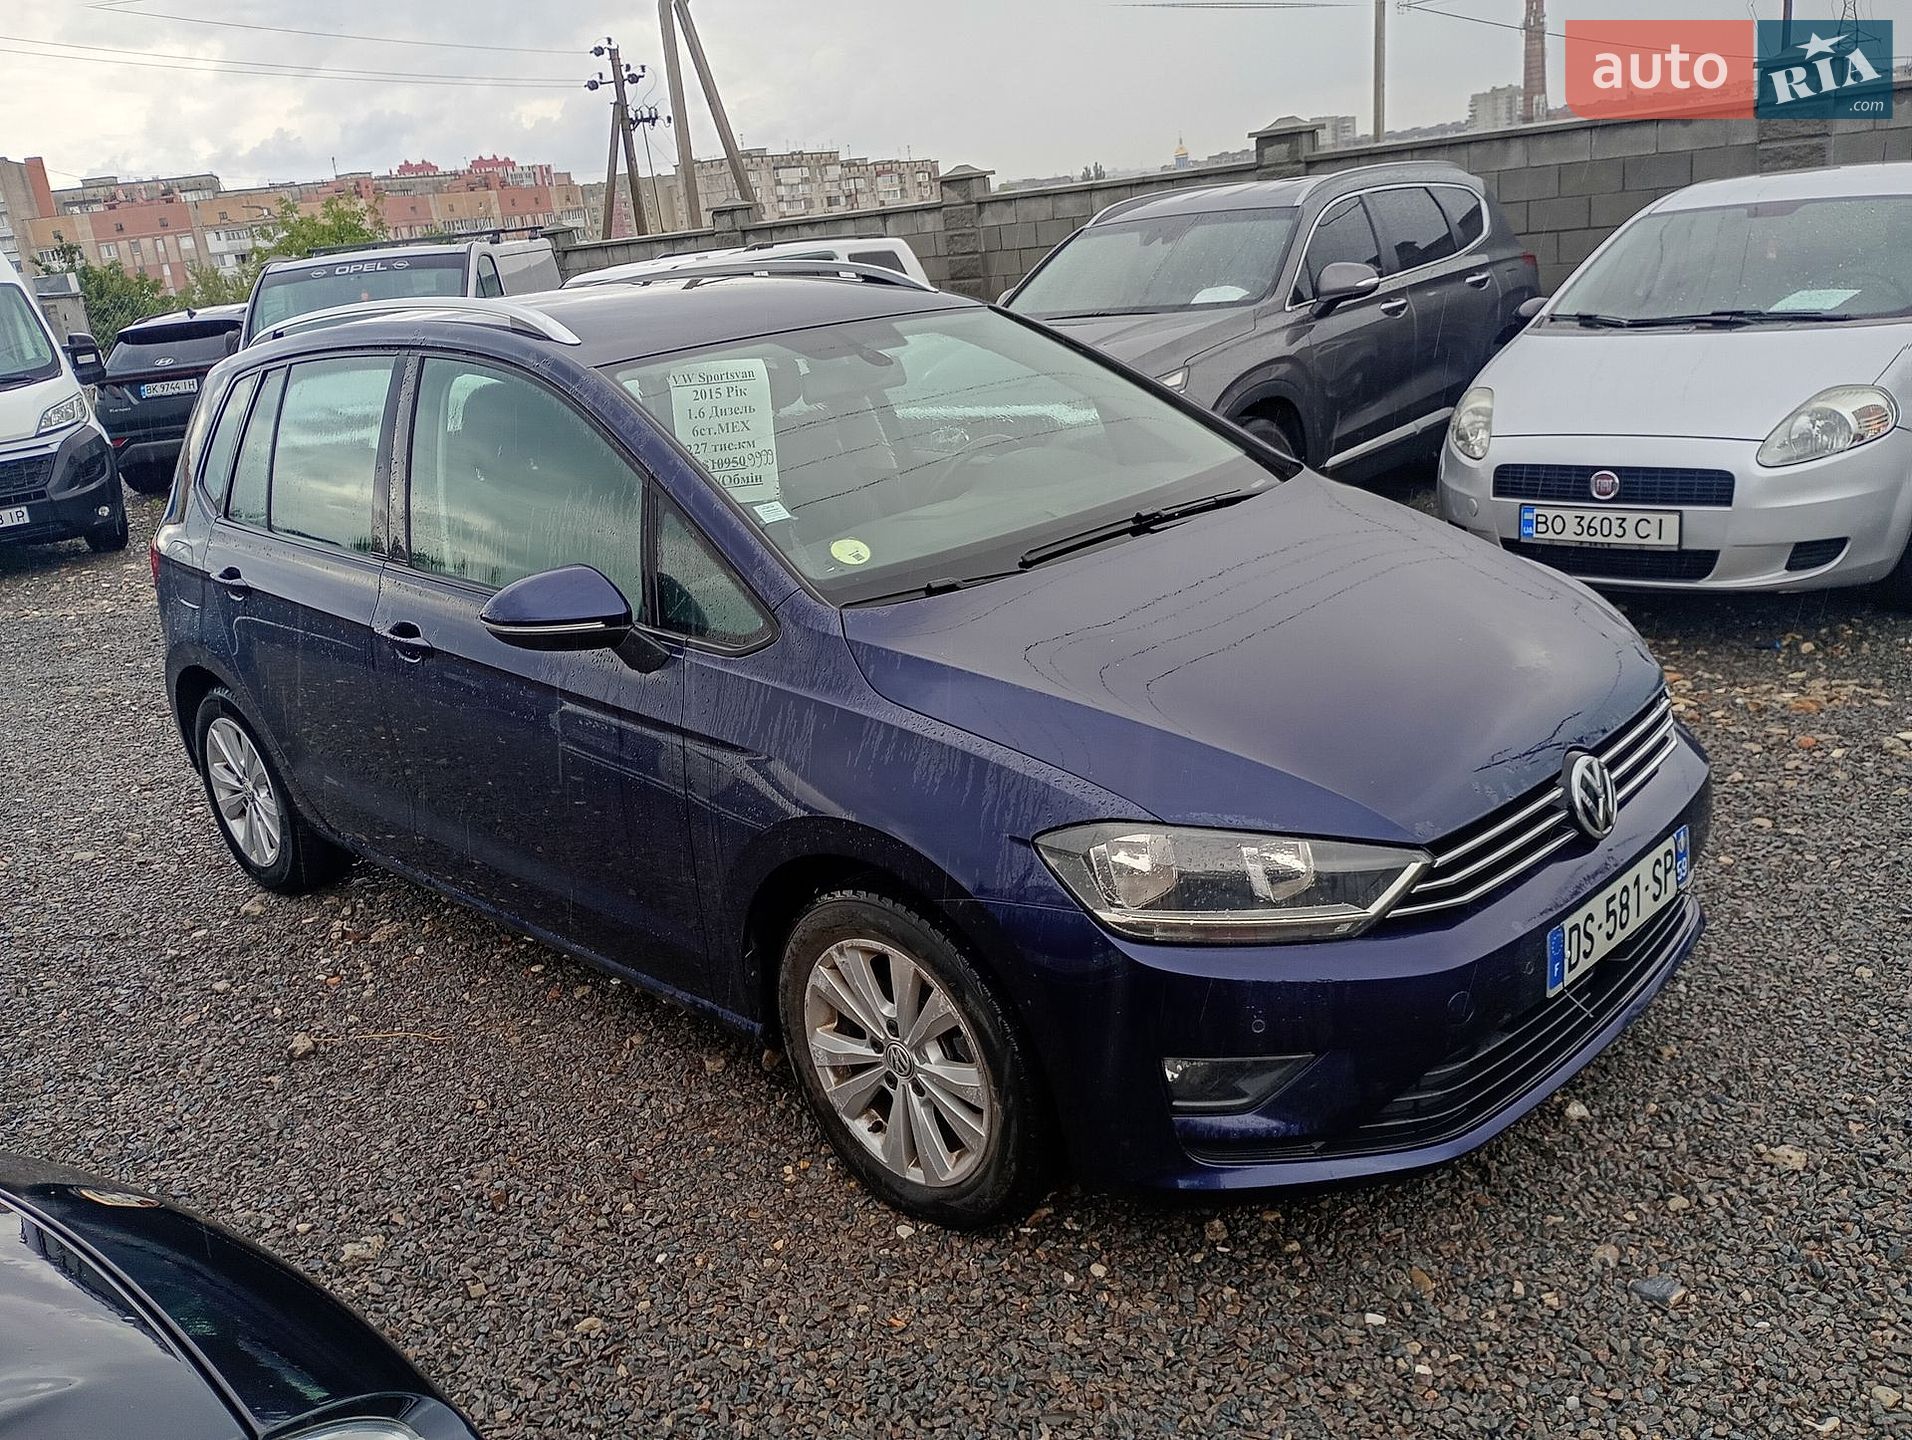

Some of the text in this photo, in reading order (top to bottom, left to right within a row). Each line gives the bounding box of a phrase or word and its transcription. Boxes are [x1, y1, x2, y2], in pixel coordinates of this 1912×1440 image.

[334, 262, 388, 276] OPEL
[672, 370, 756, 386] VW Sportsvan
[692, 384, 748, 401] 2015 Рік
[687, 404, 757, 420] 1.6 Дизель
[1596, 479, 1614, 493] FIAT
[1535, 513, 1566, 535] BO
[1573, 515, 1628, 539] 3603
[1676, 856, 1688, 882] 59
[1553, 962, 1561, 976] F
